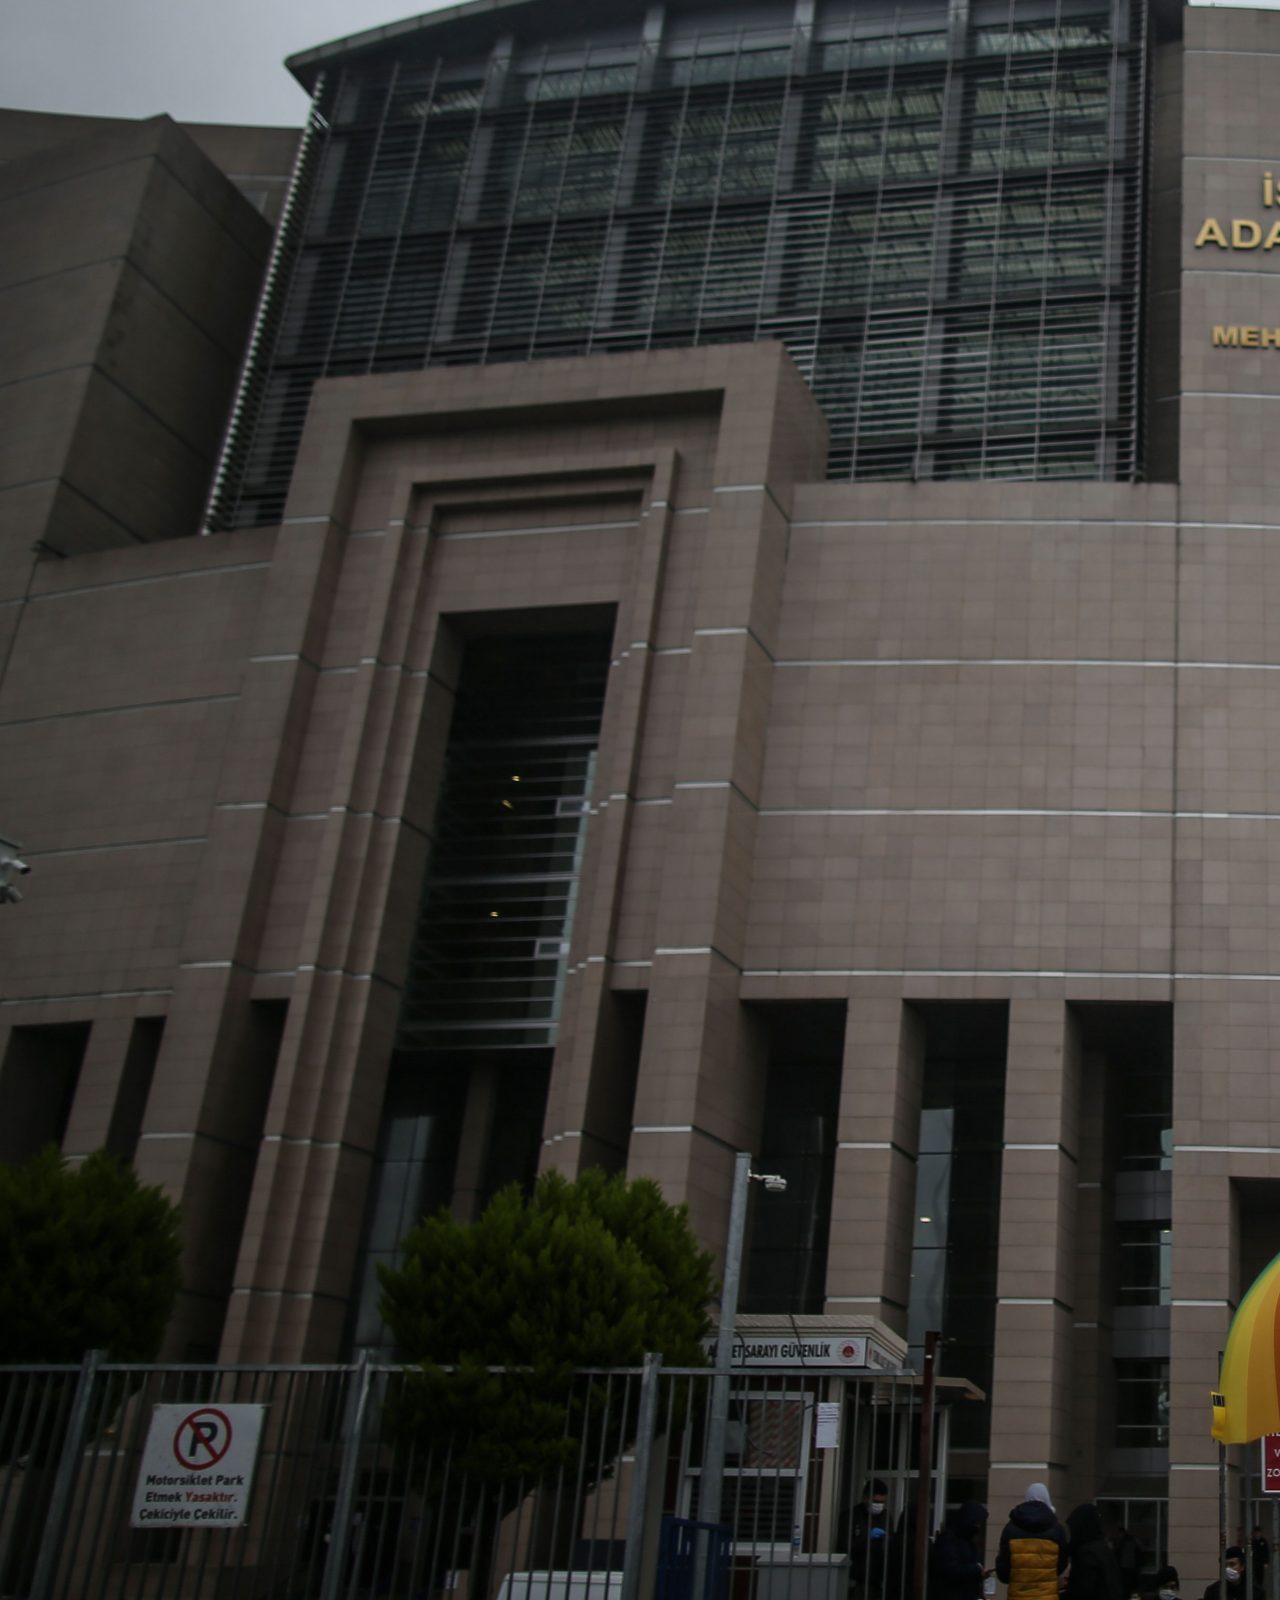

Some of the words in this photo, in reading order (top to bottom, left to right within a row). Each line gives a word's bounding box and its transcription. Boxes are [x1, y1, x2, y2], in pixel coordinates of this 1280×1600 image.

[146, 1475, 212, 1486] Motorsiklet
[215, 1475, 244, 1486] Park
[146, 1492, 182, 1502] Etmek
[185, 1492, 238, 1502] Yasaktır.
[139, 1508, 191, 1521] Çekiciyle
[193, 1508, 238, 1520] Çekilir.
